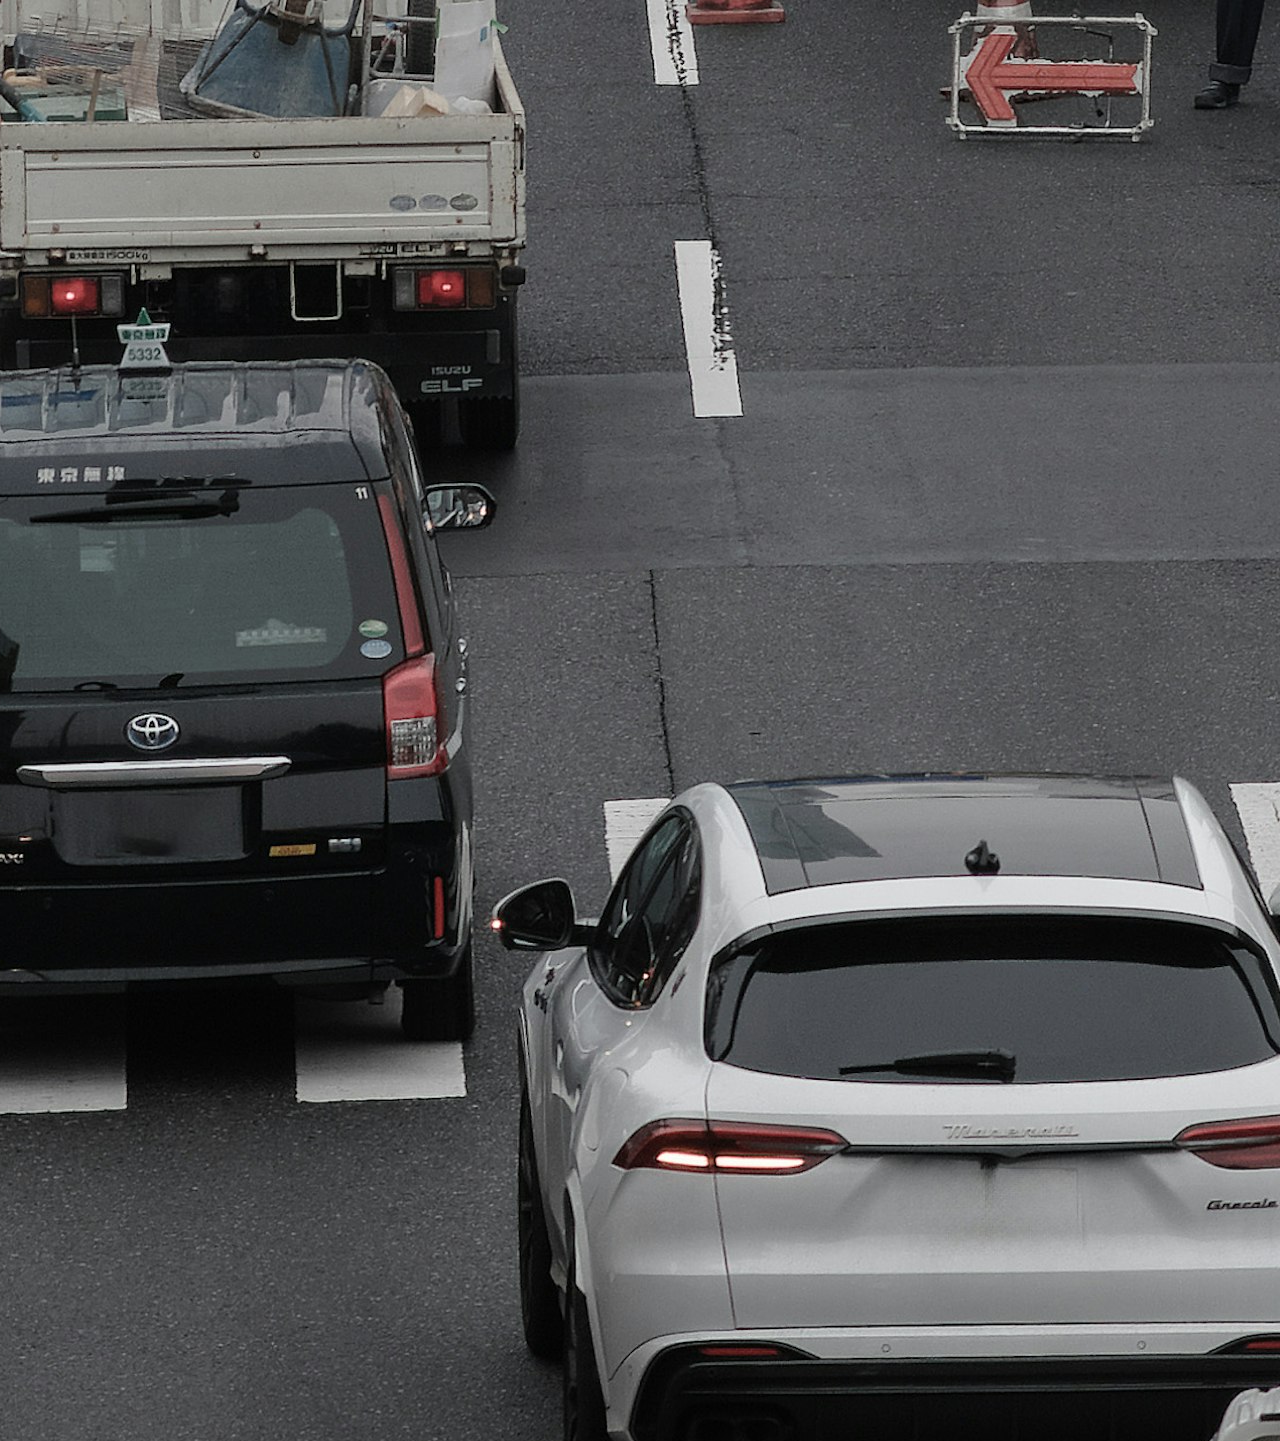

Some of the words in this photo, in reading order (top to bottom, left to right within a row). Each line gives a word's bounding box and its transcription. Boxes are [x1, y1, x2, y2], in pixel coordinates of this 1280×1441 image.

[127, 347, 162, 362] 5332
[431, 365, 473, 376] ISUZU
[420, 378, 485, 394] ELF
[36, 466, 127, 484] 東京無線
[355, 487, 368, 500] 11
[942, 1123, 1081, 1139] Maserati
[1206, 1198, 1280, 1211] Grecale
